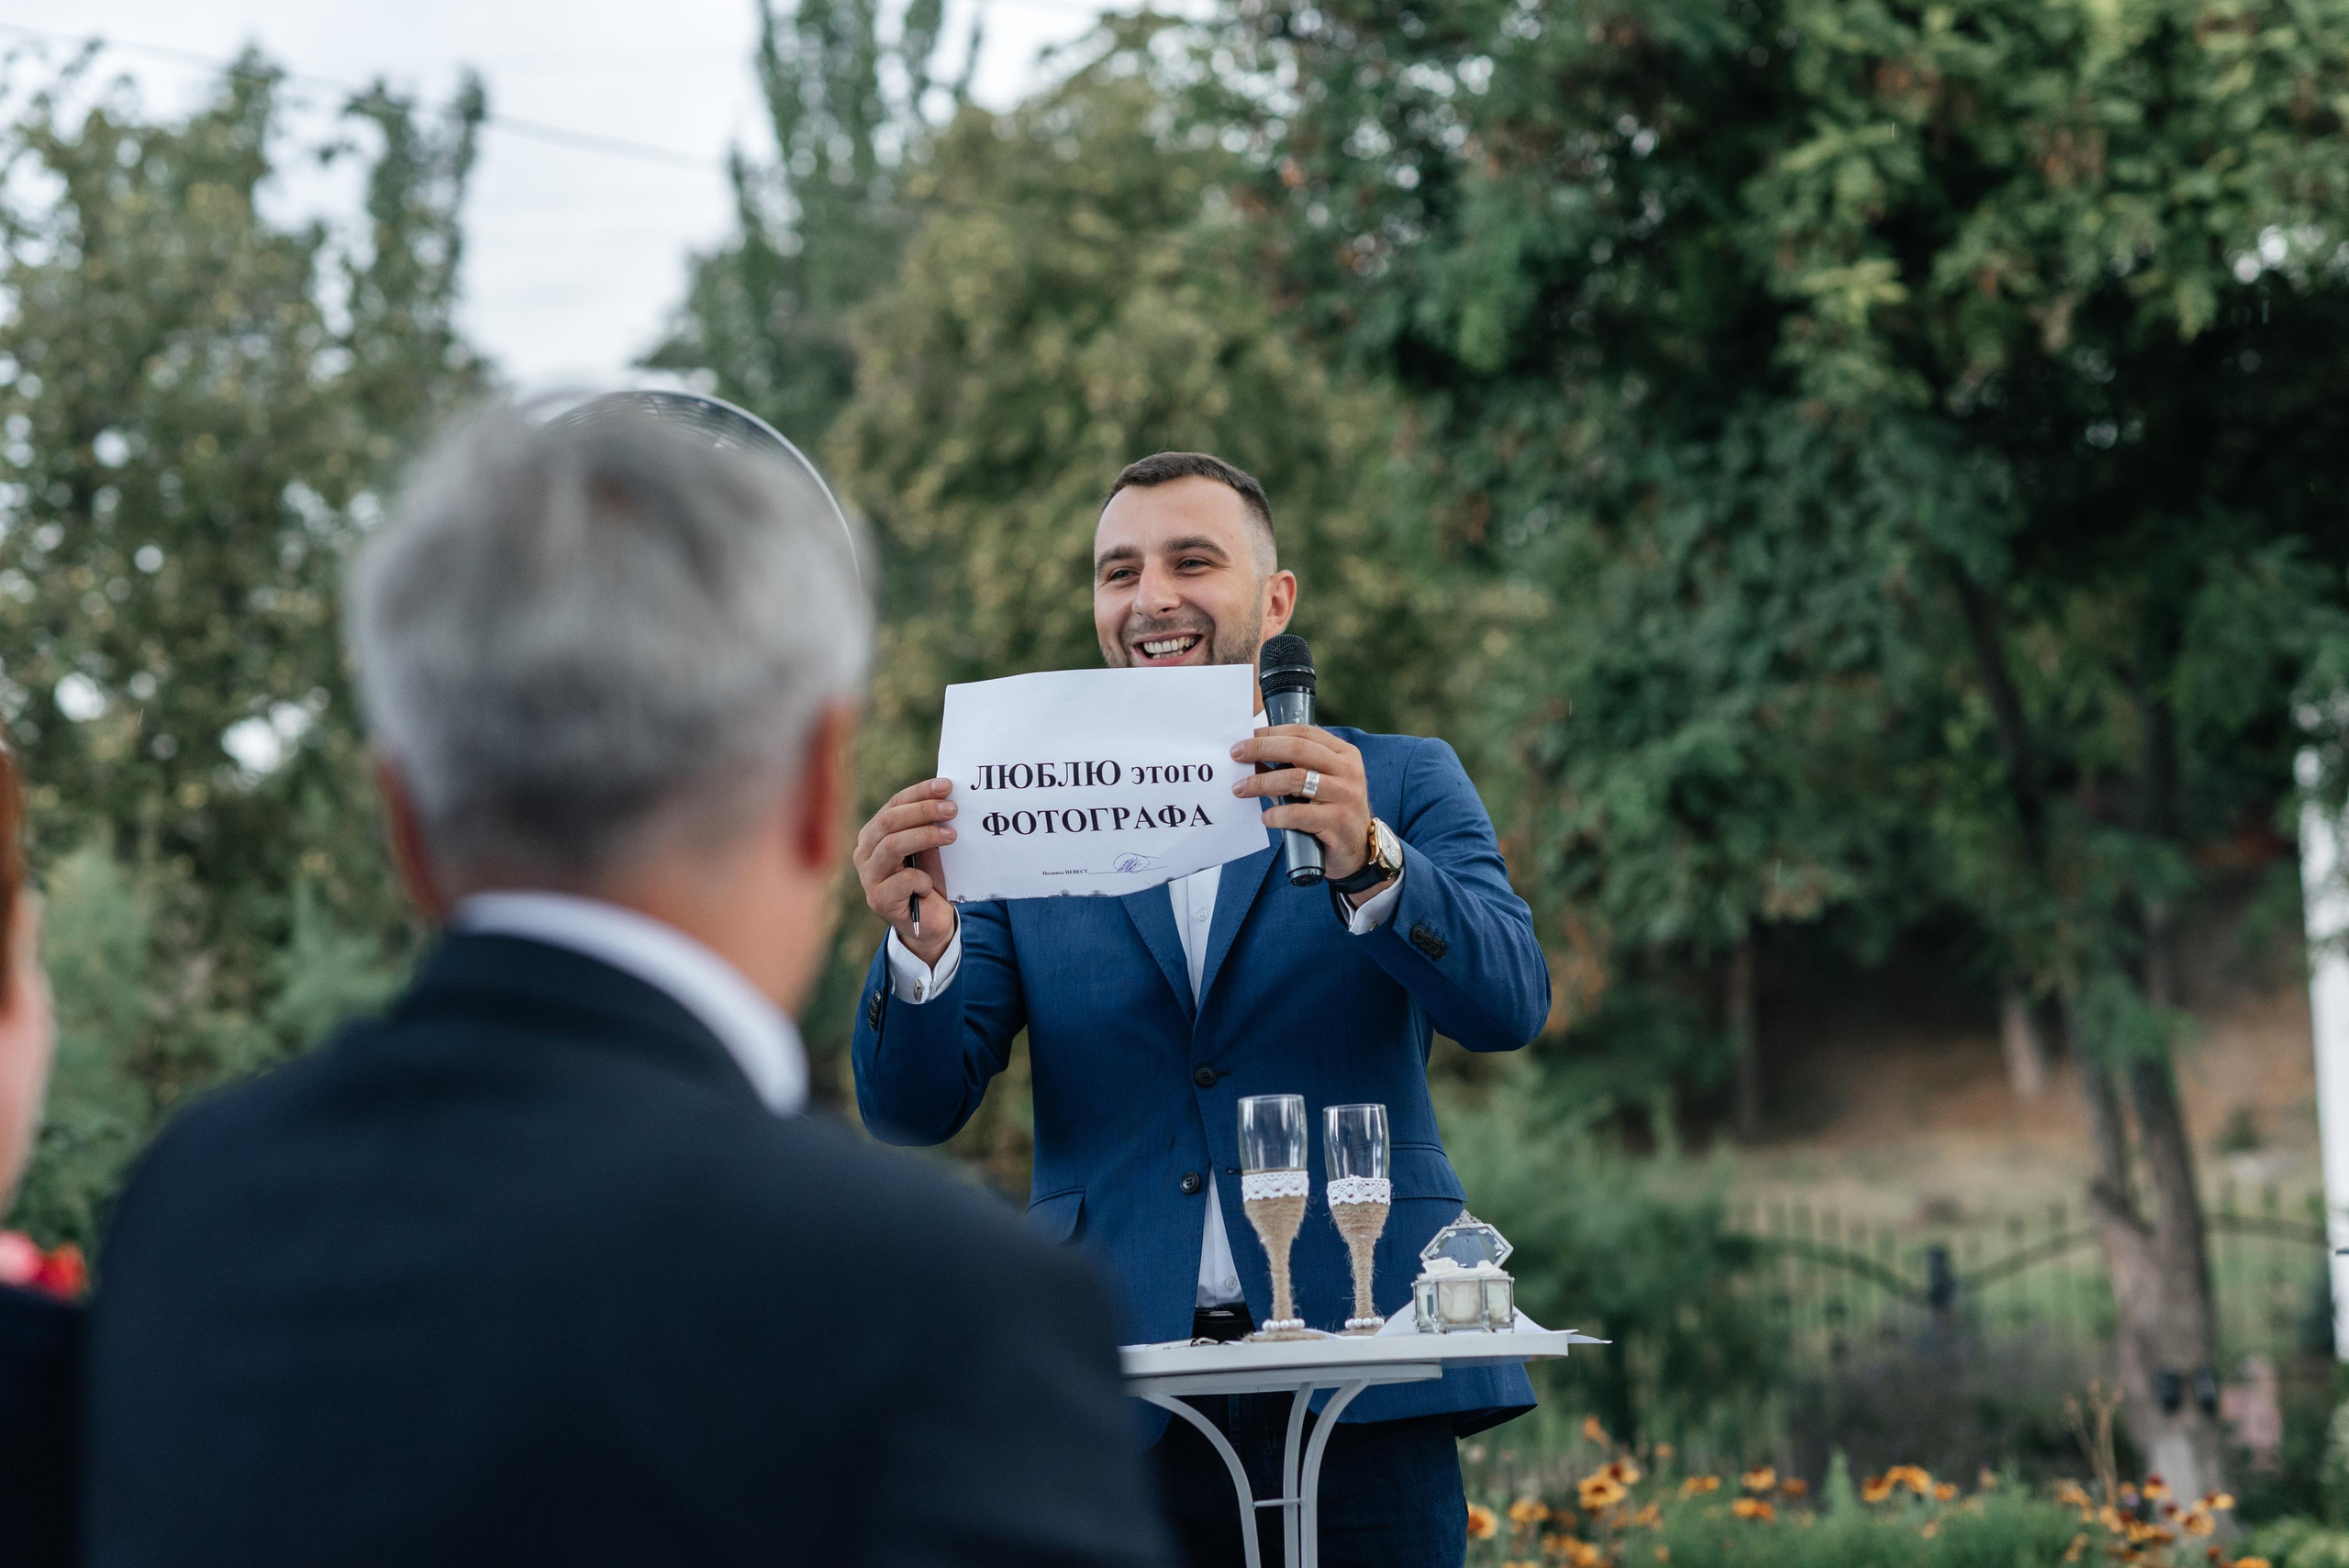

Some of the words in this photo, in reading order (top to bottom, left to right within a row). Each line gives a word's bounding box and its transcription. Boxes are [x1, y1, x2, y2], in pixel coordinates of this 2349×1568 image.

[970, 760, 1121, 790] ЛЮБЛЮ
[1130, 763, 1214, 785] этого
[982, 803, 1215, 837] ФОТОГРАФА
